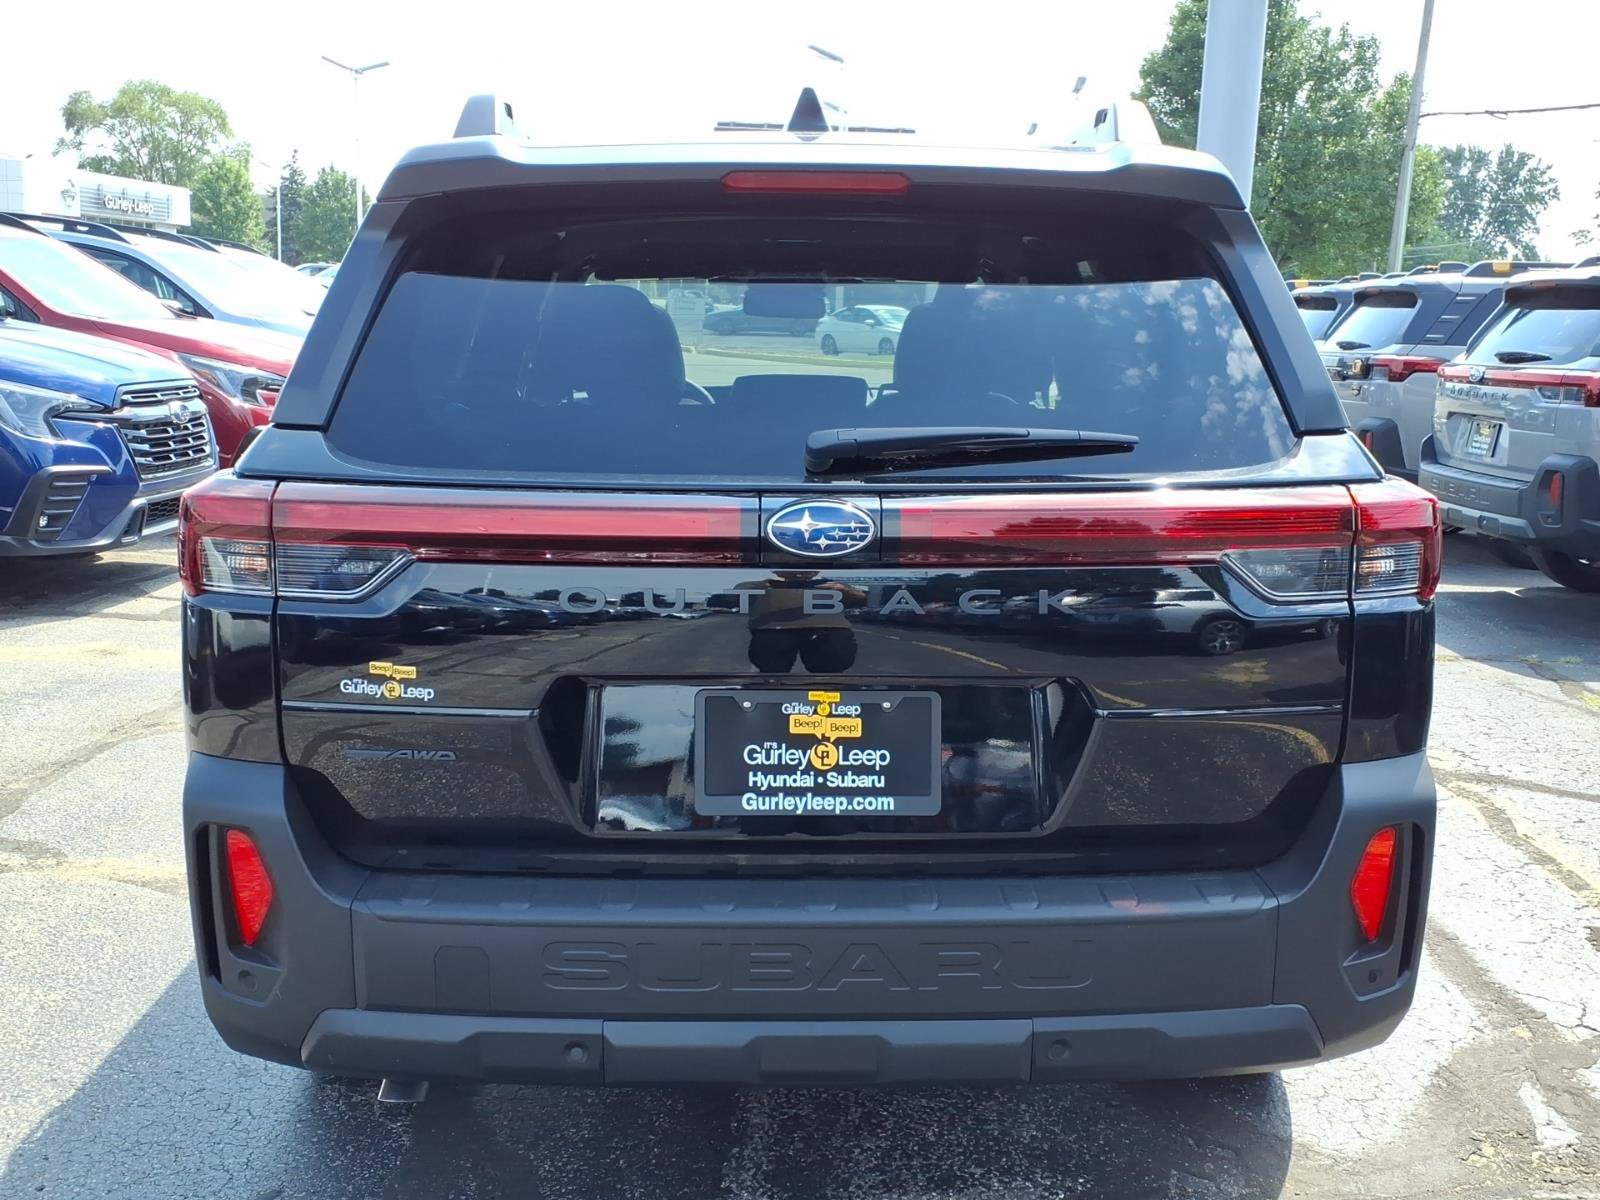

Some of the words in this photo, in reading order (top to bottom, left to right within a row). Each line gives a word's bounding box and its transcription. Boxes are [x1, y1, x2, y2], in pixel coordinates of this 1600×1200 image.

[558, 586, 1077, 615] OUTBACK
[370, 663, 392, 672] Beep!
[340, 679, 383, 698] Gurley
[401, 684, 435, 702] Leep
[781, 703, 815, 716] Gurley
[831, 703, 861, 717] Leep
[793, 719, 823, 730] Beep!
[830, 723, 859, 733] Beep!
[386, 749, 457, 761] AWD
[743, 743, 811, 770] Gurley
[838, 745, 891, 771] Leep
[748, 771, 815, 791] Hyundai
[826, 771, 886, 788] Subaru
[741, 792, 895, 814] Gurleyleep.com
[542, 940, 1094, 992] SUBARU
